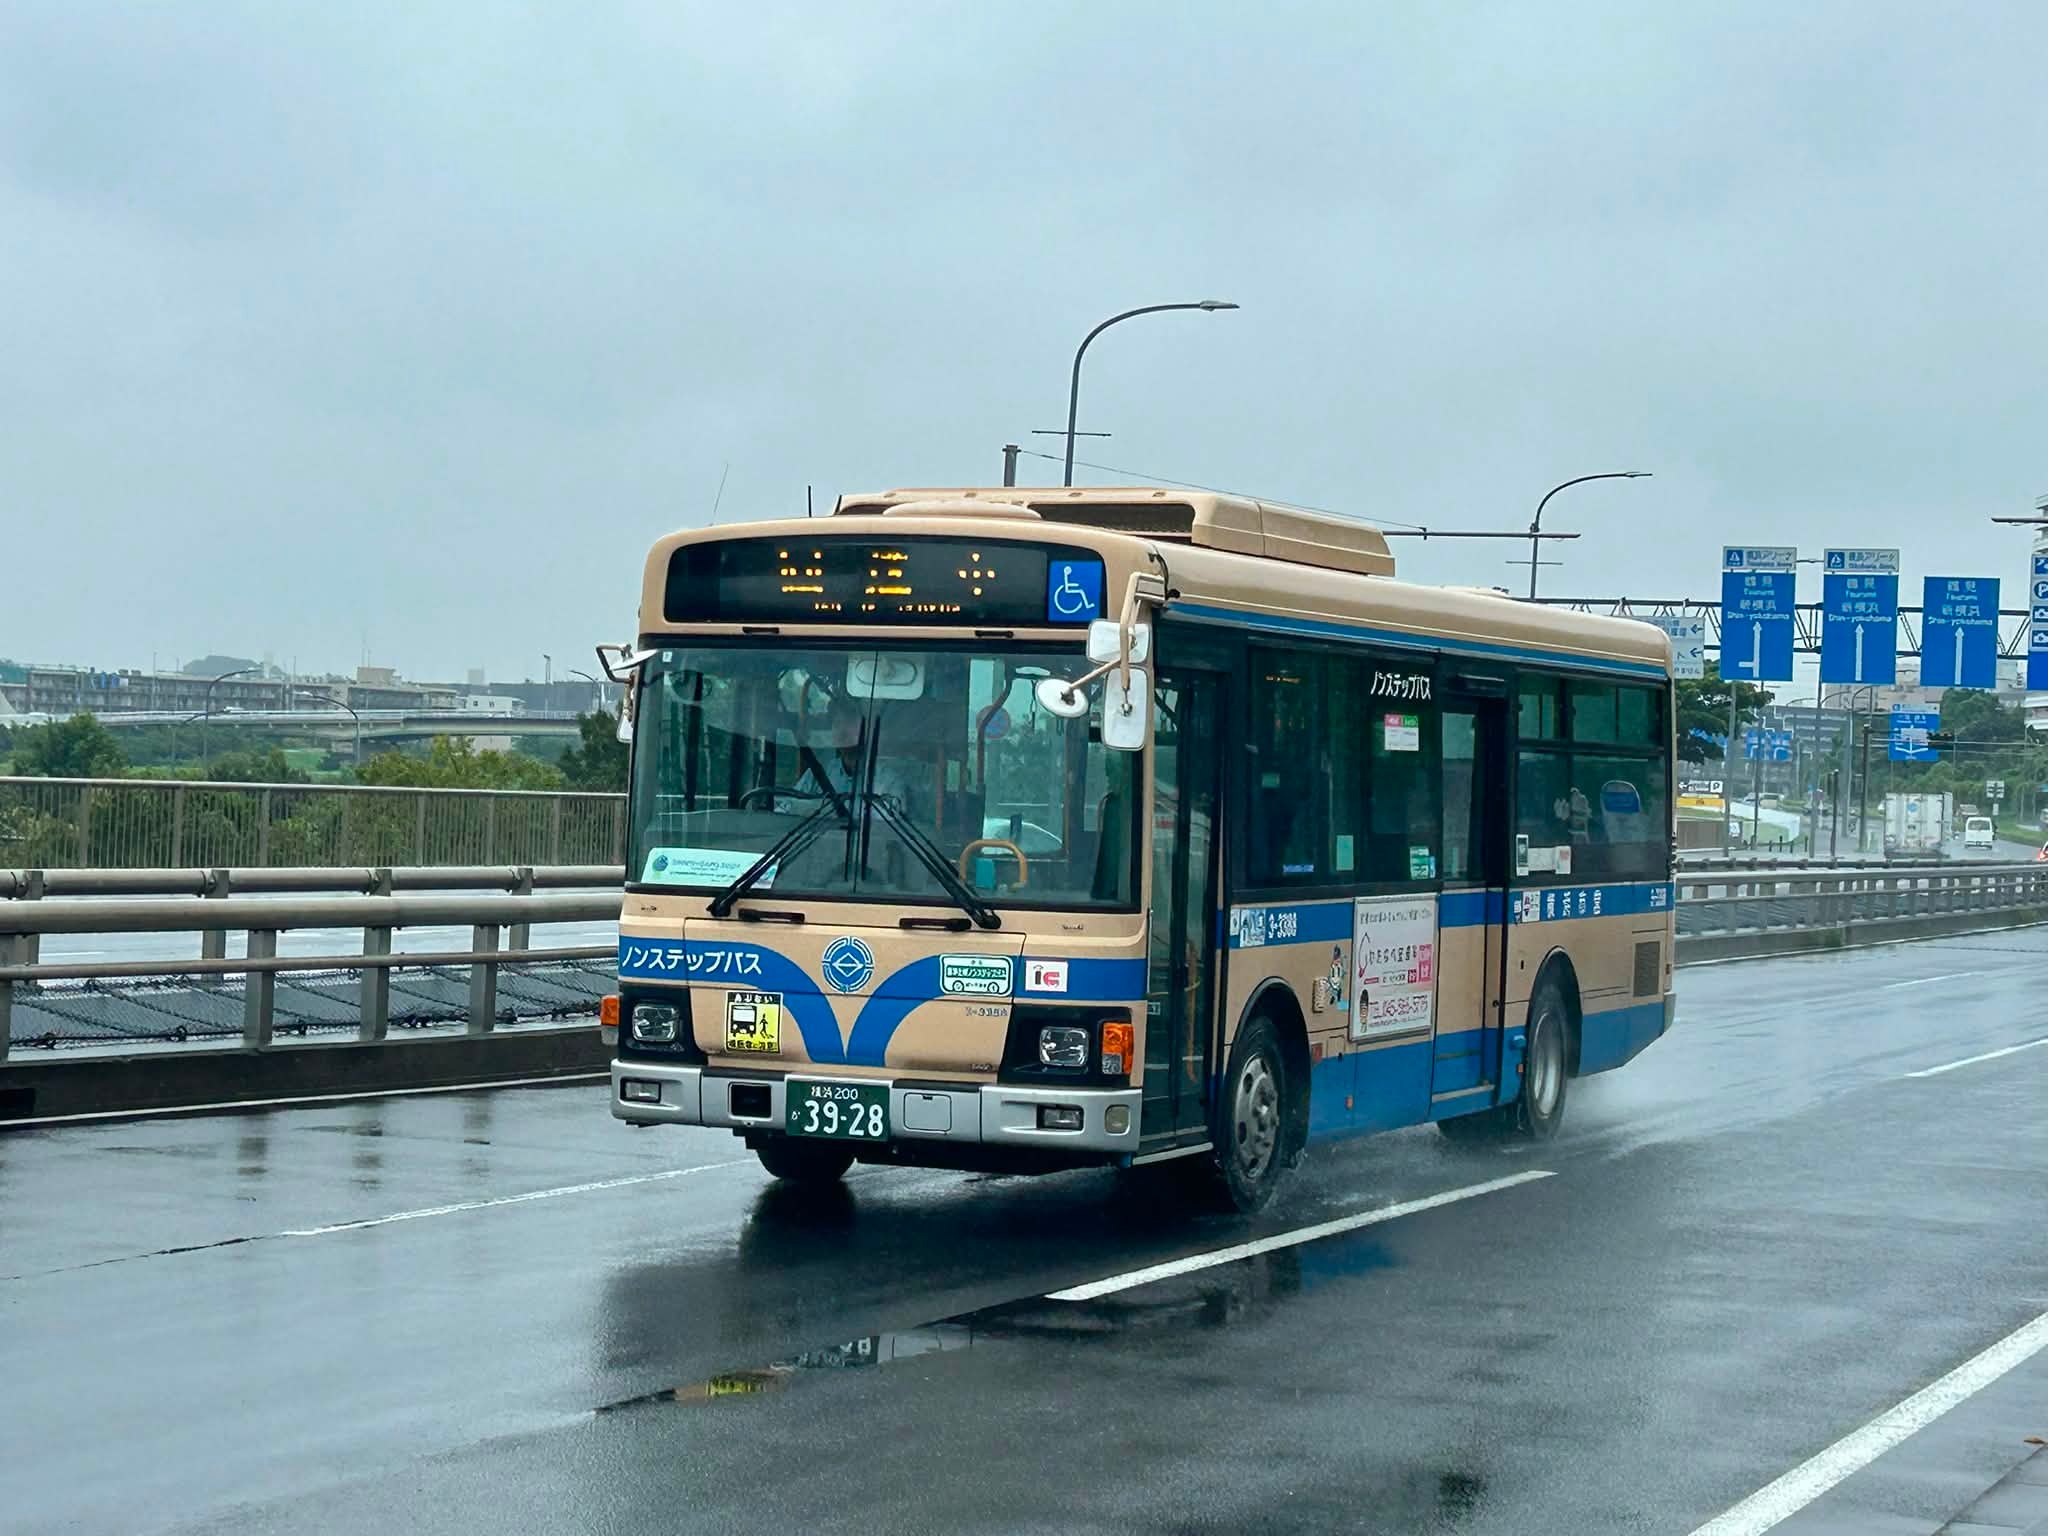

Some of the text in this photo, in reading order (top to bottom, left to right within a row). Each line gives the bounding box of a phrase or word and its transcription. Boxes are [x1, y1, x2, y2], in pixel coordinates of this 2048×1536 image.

[1370, 671, 1431, 700] ノンステップバス
[621, 946, 762, 975] ノンステップバス
[834, 1087, 859, 1100] 200
[803, 1100, 884, 1137] 39-28
